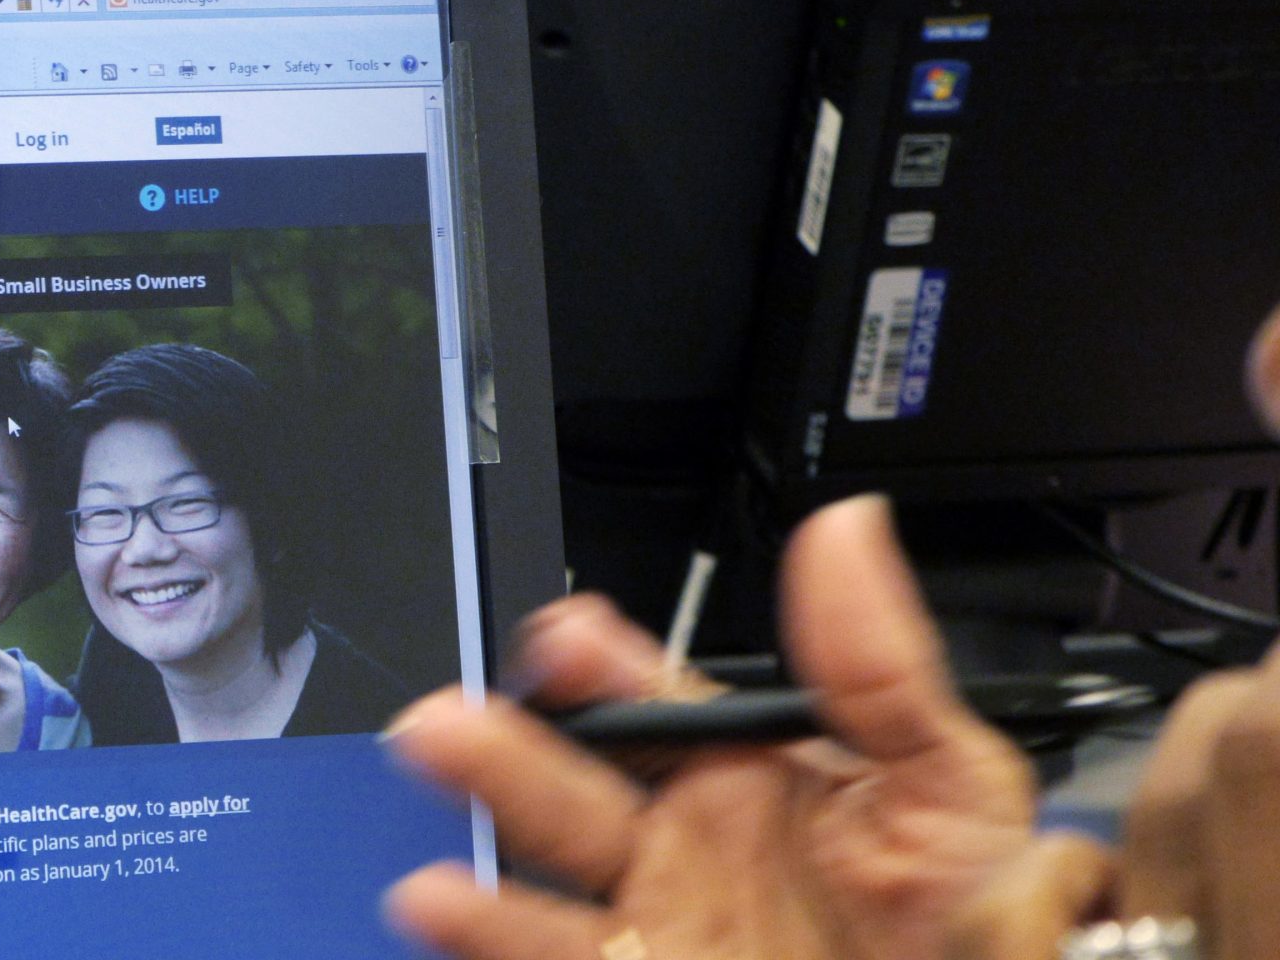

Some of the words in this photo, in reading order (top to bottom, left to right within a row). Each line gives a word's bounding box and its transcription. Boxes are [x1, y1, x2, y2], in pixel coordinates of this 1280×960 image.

[228, 61, 259, 77] Page
[284, 59, 321, 76] Safety
[346, 57, 379, 73] Tools
[15, 130, 45, 151] Log
[51, 130, 70, 147] in
[162, 122, 216, 139] Español
[174, 187, 220, 206] HELP
[51, 273, 132, 293] Business
[136, 272, 207, 291] Owners
[146, 800, 164, 816] to
[169, 796, 219, 818] apply
[223, 795, 251, 812] for
[32, 833, 80, 855] plans
[83, 830, 117, 848] and
[122, 829, 175, 851] prices
[178, 827, 208, 843] are
[20, 866, 40, 881] as
[42, 861, 110, 883] January
[115, 859, 130, 878] 1,
[134, 857, 180, 876] 2014.
